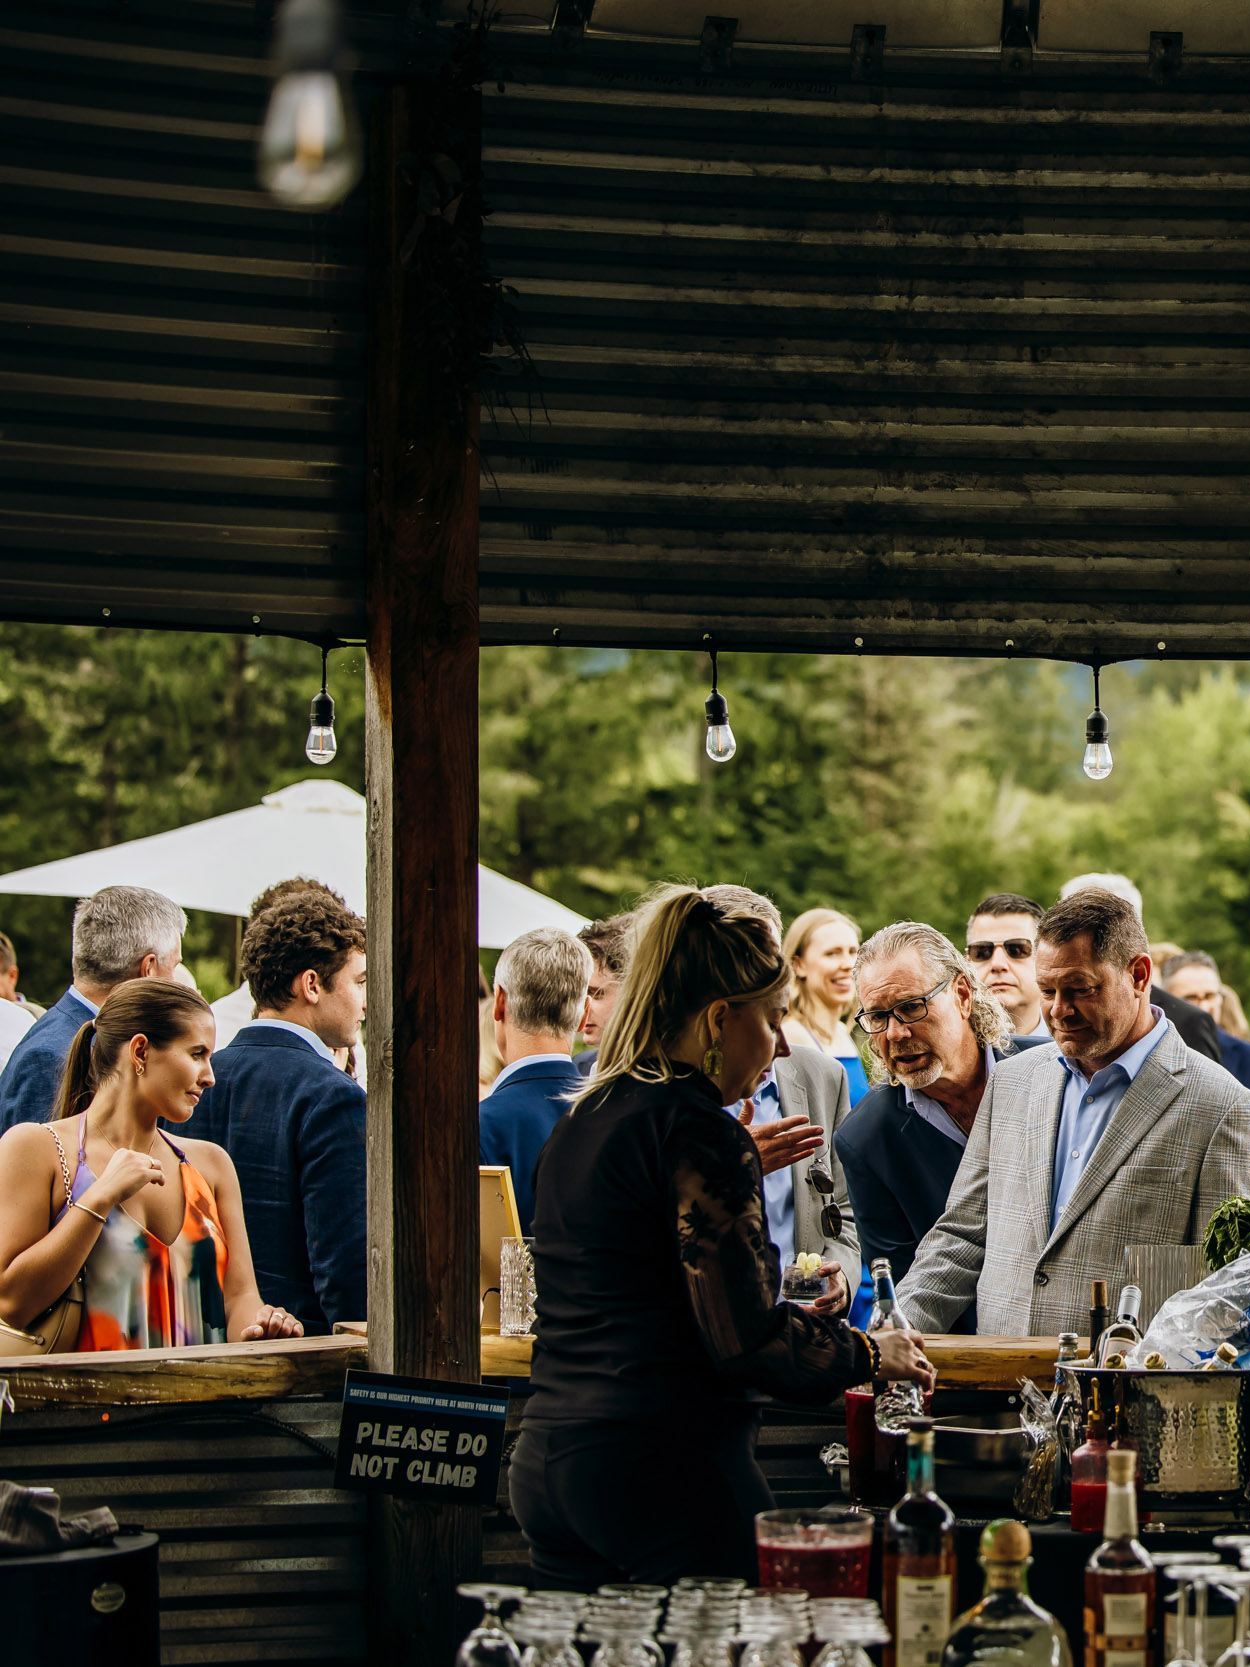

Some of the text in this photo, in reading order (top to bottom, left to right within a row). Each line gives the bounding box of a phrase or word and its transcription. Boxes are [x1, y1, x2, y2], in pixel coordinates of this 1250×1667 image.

[349, 1388, 505, 1413] SAFETY IS OUR HIGHEST PRIORITY HERE AT NORTH FORK FARM
[356, 1421, 488, 1457] PLEASE DO
[350, 1453, 478, 1488] NOT CLIMB
